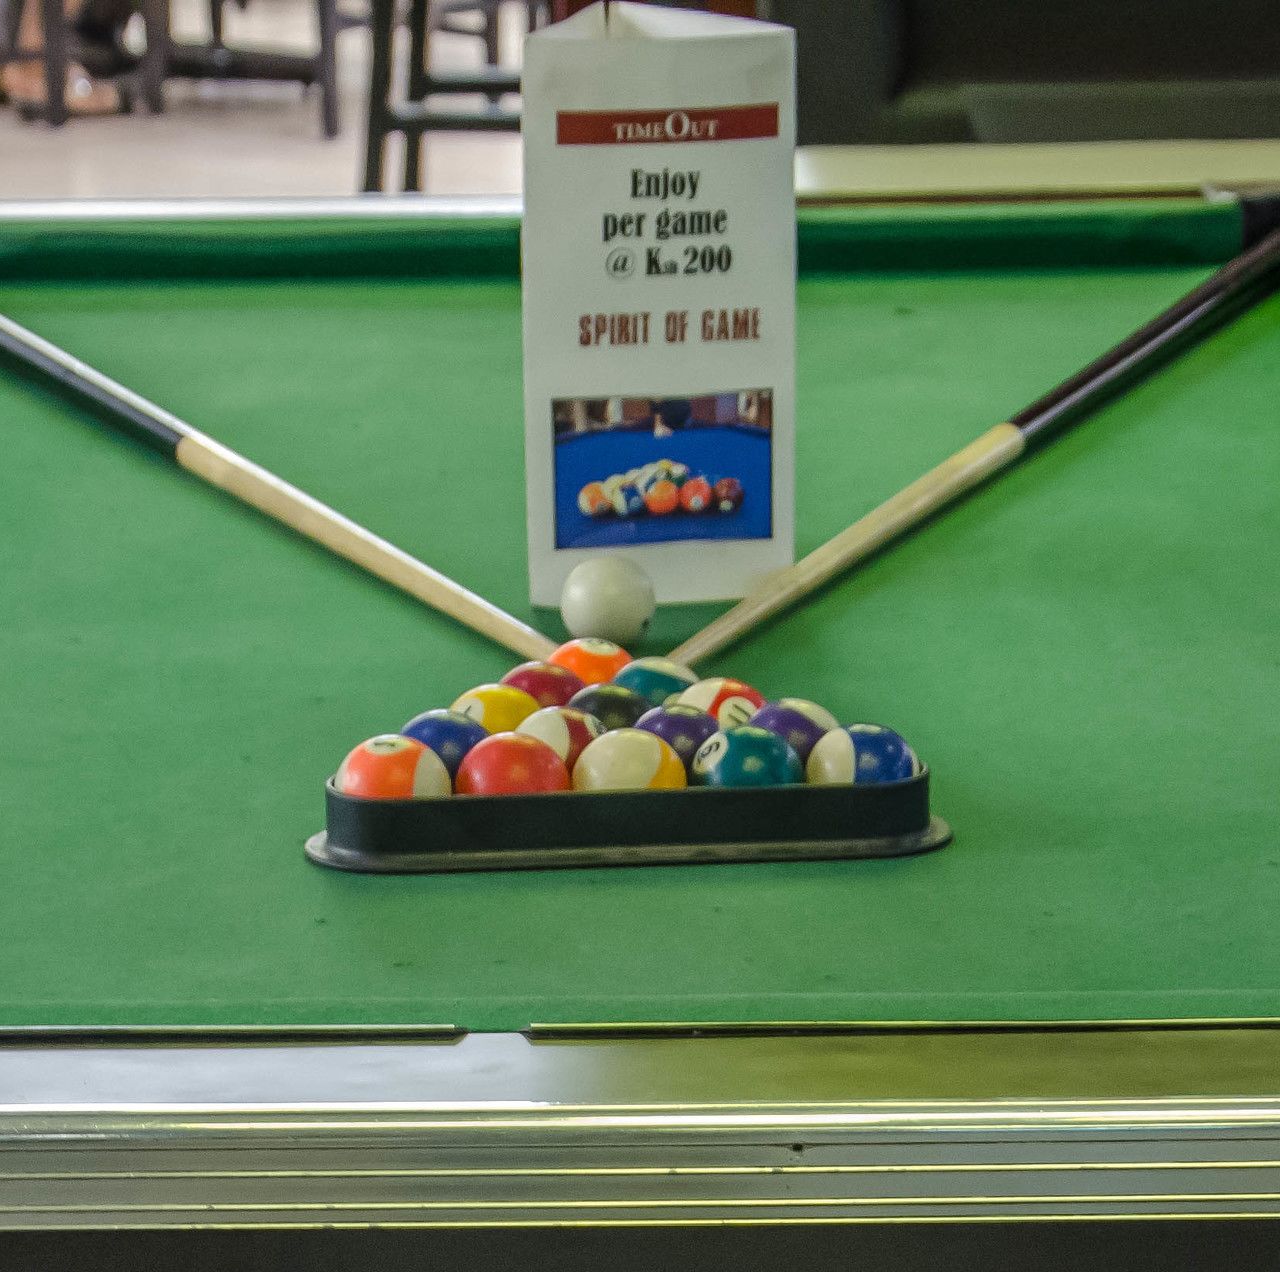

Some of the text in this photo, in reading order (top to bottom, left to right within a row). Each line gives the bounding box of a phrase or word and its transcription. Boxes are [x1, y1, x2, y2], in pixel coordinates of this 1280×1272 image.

[630, 167, 700, 200] Enjoy
[602, 208, 728, 241] per game
[605, 246, 636, 279] @
[683, 244, 732, 275] 200
[578, 307, 760, 346] SPIRIT OF GAME
